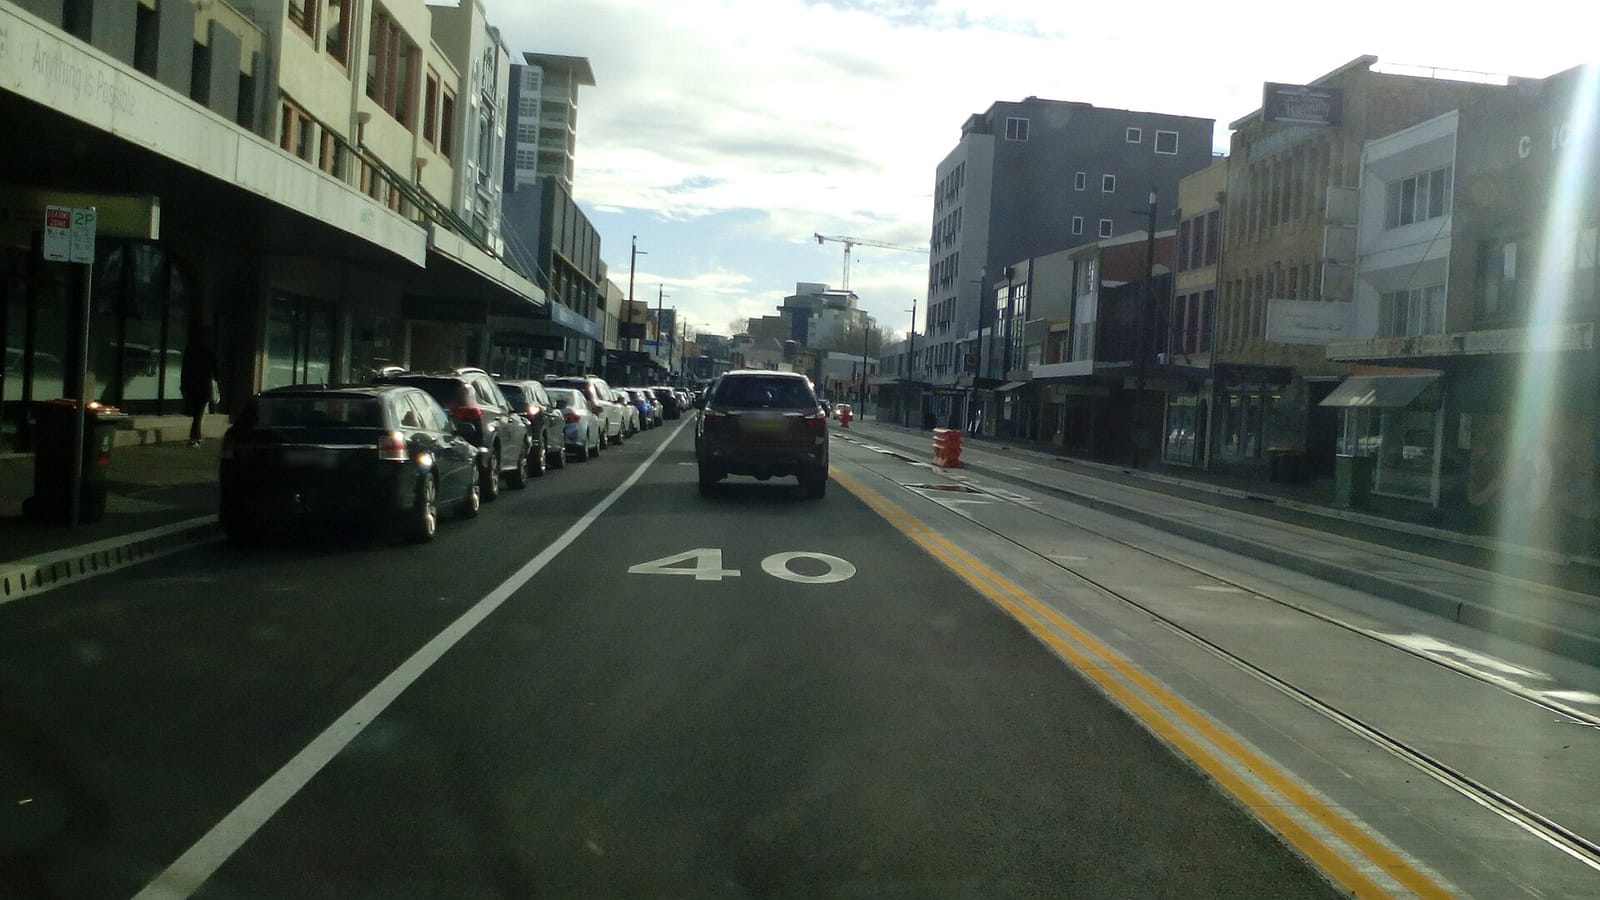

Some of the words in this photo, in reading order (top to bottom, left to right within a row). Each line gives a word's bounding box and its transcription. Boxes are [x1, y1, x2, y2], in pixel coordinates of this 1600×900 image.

[32, 37, 81, 102] Anything
[96, 69, 136, 116] Possible
[74, 212, 94, 226] 2P
[627, 548, 857, 583] 40
